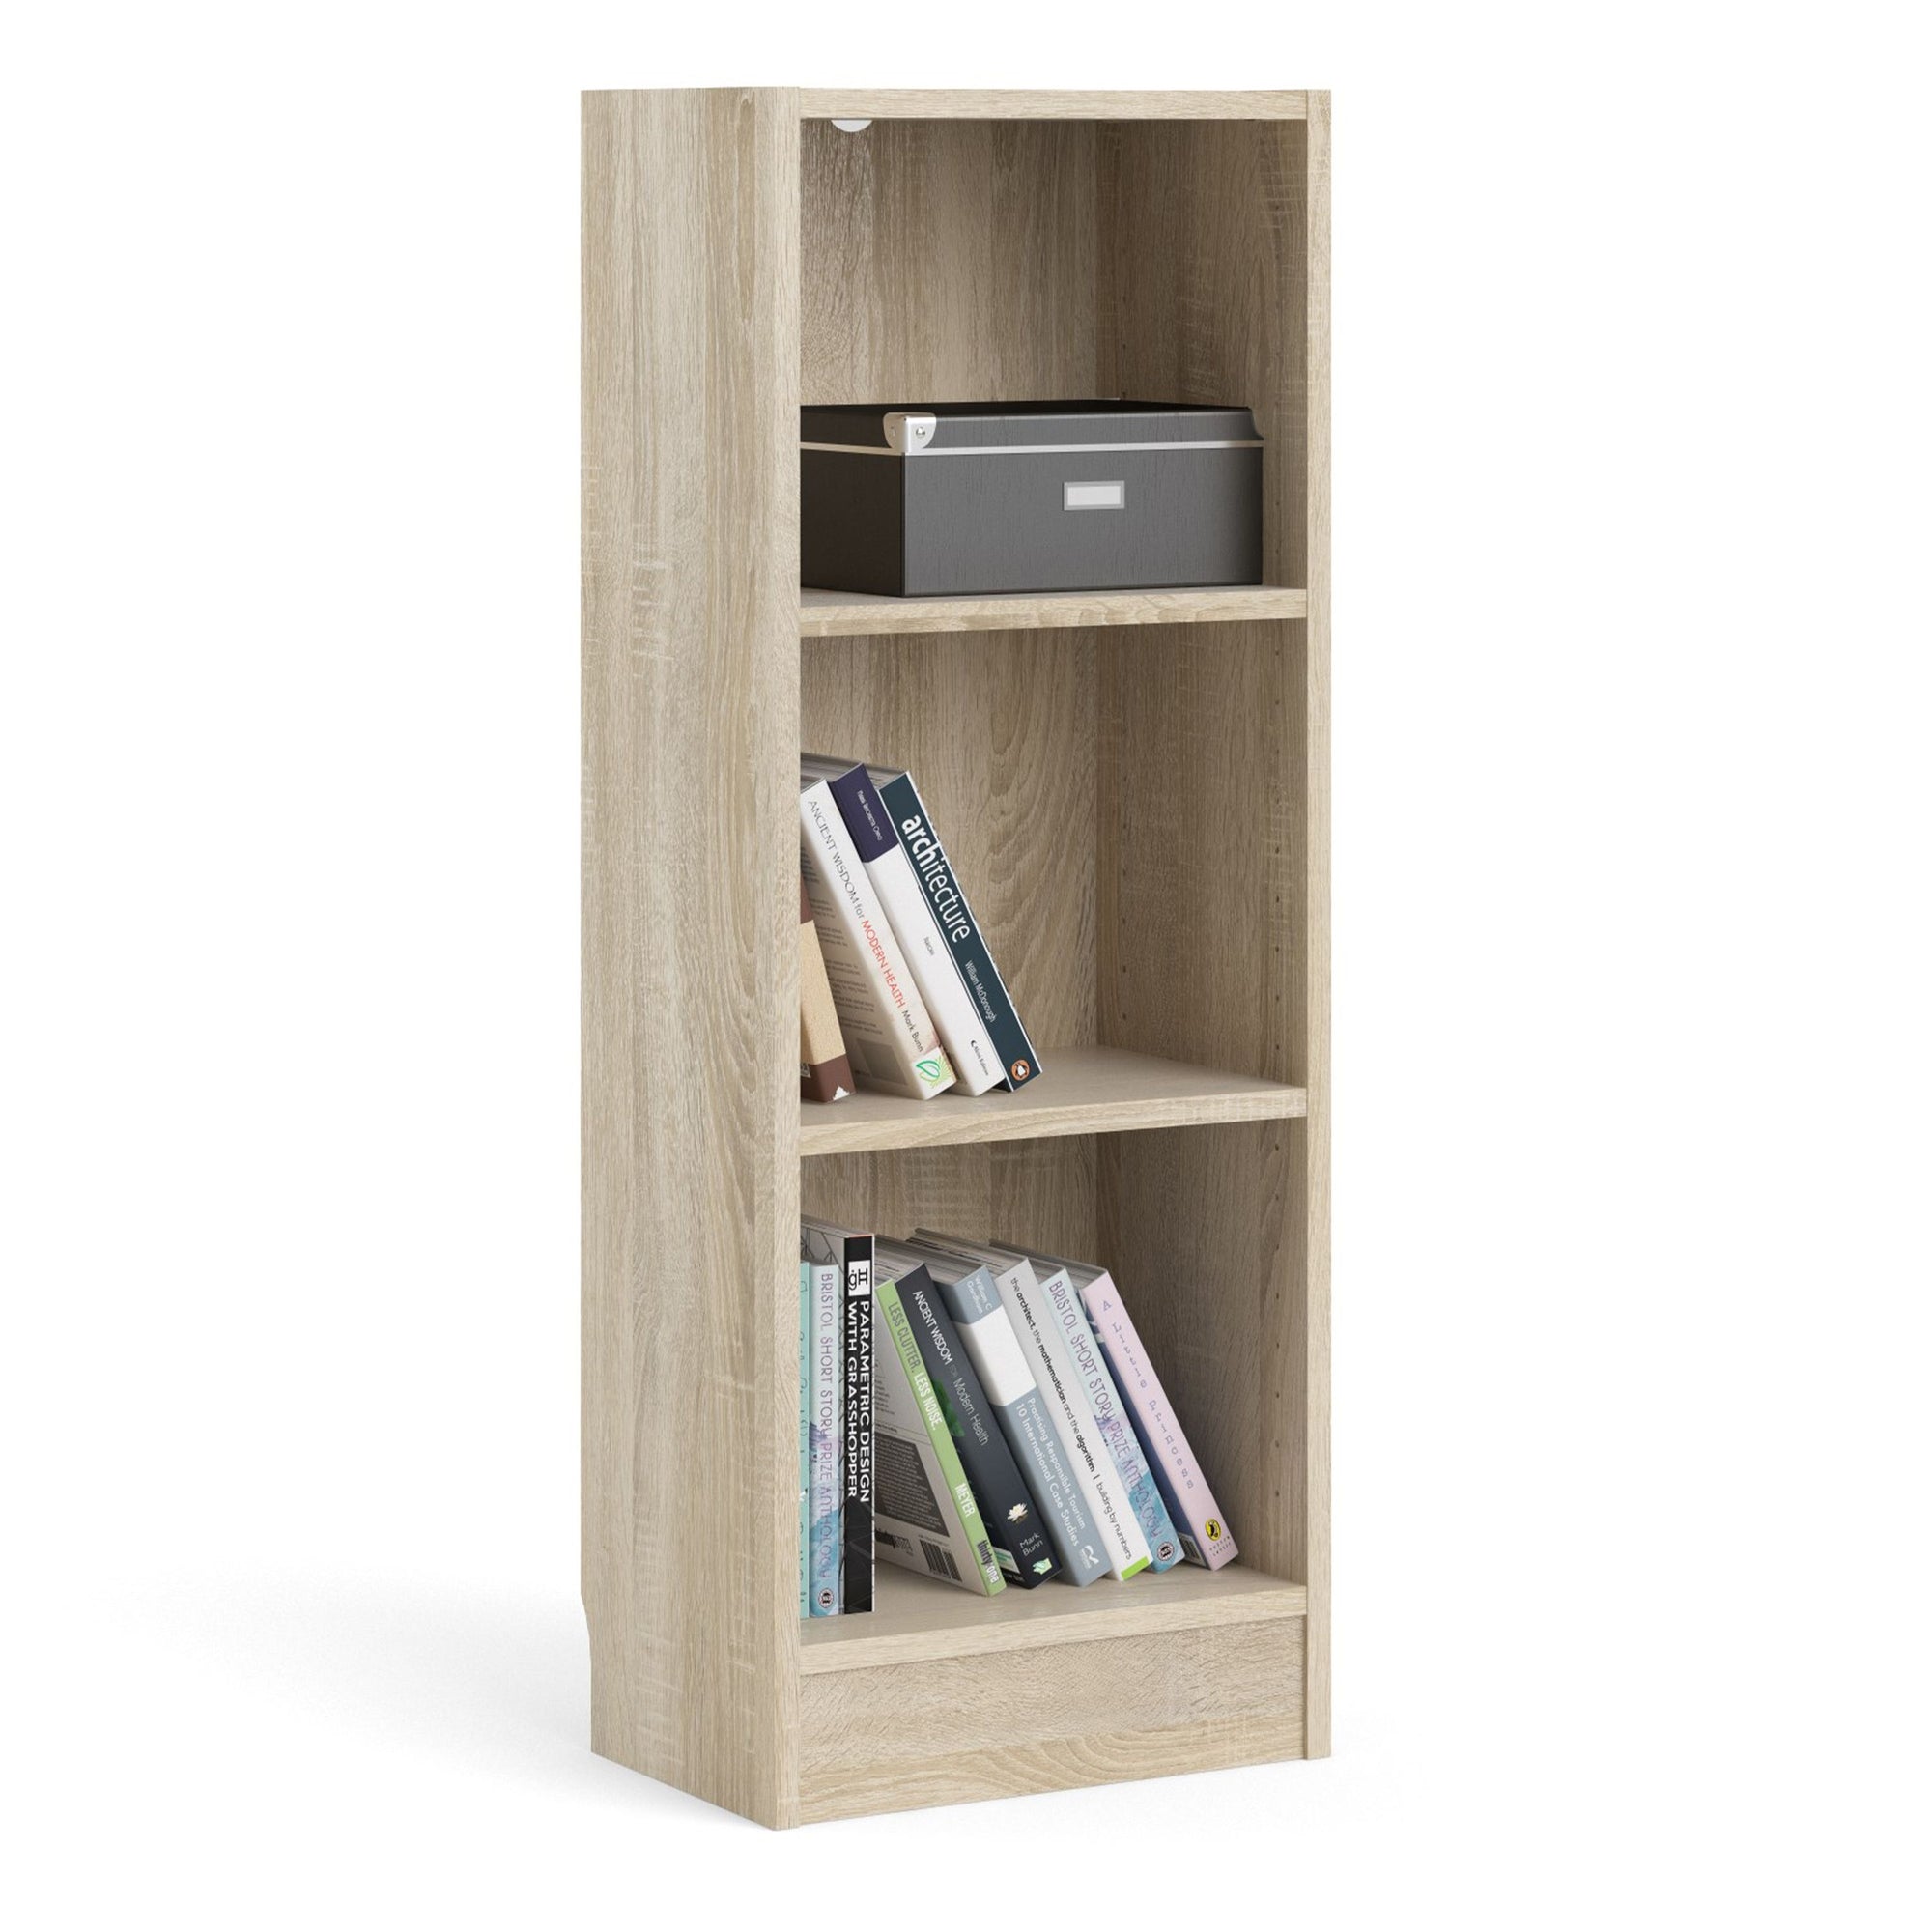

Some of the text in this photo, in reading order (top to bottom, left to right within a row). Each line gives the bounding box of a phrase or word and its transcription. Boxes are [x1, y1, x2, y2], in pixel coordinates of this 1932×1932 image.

[808, 800, 837, 850] ANCIENT
[832, 851, 859, 904] WISDOM
[862, 920, 888, 969] MODERN
[883, 968, 906, 1009] HEALTH
[901, 1010, 915, 1032] Mark
[911, 1031, 923, 1053] Bunn
[901, 814, 971, 943] architecture
[965, 960, 980, 985] William
[820, 1273, 833, 1331] BRISTOL
[888, 1301, 905, 1327] LESS
[914, 1372, 930, 1397] LESS
[1103, 1300, 1112, 1312] A
[820, 1336, 833, 1383] SHORT
[848, 1301, 858, 1497] WITH GRASSHOPPER
[860, 1300, 870, 1502] PARAMETRIC DESIGN
[912, 1290, 937, 1328] ANCIENT
[930, 1325, 953, 1366] WISDOM
[952, 1377, 975, 1415] Modern
[971, 1413, 990, 1446] Health
[1049, 1280, 1079, 1335] BRISTOL
[1070, 1333, 1098, 1376] SHORT
[1089, 1378, 1117, 1424] STORY
[1107, 1420, 1131, 1458] PRIZE
[820, 1389, 833, 1438] STORY
[820, 1442, 833, 1481] PRIZE
[1010, 1277, 1020, 1293] the
[1016, 1292, 1037, 1331] architect,
[1033, 1328, 1041, 1345] the
[1038, 1344, 1066, 1405] mathematician
[1064, 1403, 1074, 1421] and
[1069, 1417, 1079, 1434] the
[1075, 1434, 1095, 1473] algorithm
[1096, 1482, 1112, 1515] building
[1109, 1511, 1118, 1524] by
[1114, 1523, 1132, 1560] numbers
[954, 1483, 976, 1518] MEYER
[1016, 1403, 1079, 1547] 10 International Case Studies
[1028, 1397, 1048, 1442] Practising
[1045, 1440, 1071, 1494] Responsible
[1068, 1493, 1087, 1530] Tourism
[1019, 1532, 1040, 1549] Mark
[1022, 1540, 1043, 1556] Bunn
